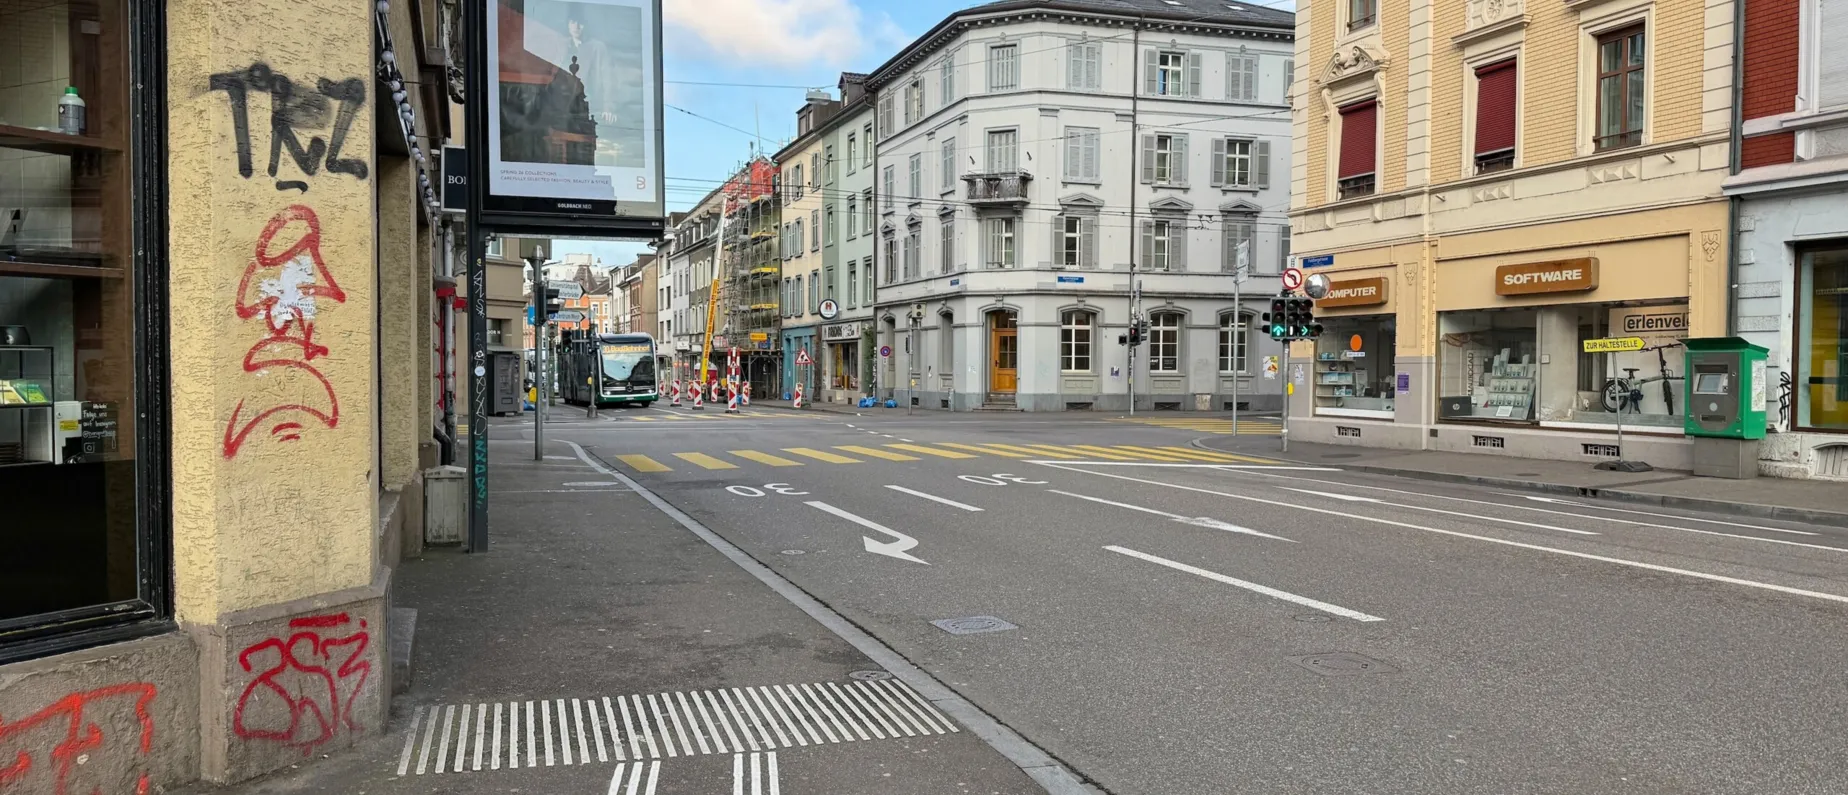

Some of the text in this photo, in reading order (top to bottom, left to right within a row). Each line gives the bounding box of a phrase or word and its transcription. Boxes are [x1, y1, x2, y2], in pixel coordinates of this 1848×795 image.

[1504, 268, 1583, 285] SOFTWARE
[1586, 339, 1638, 350] ZUR HALTESTELLE
